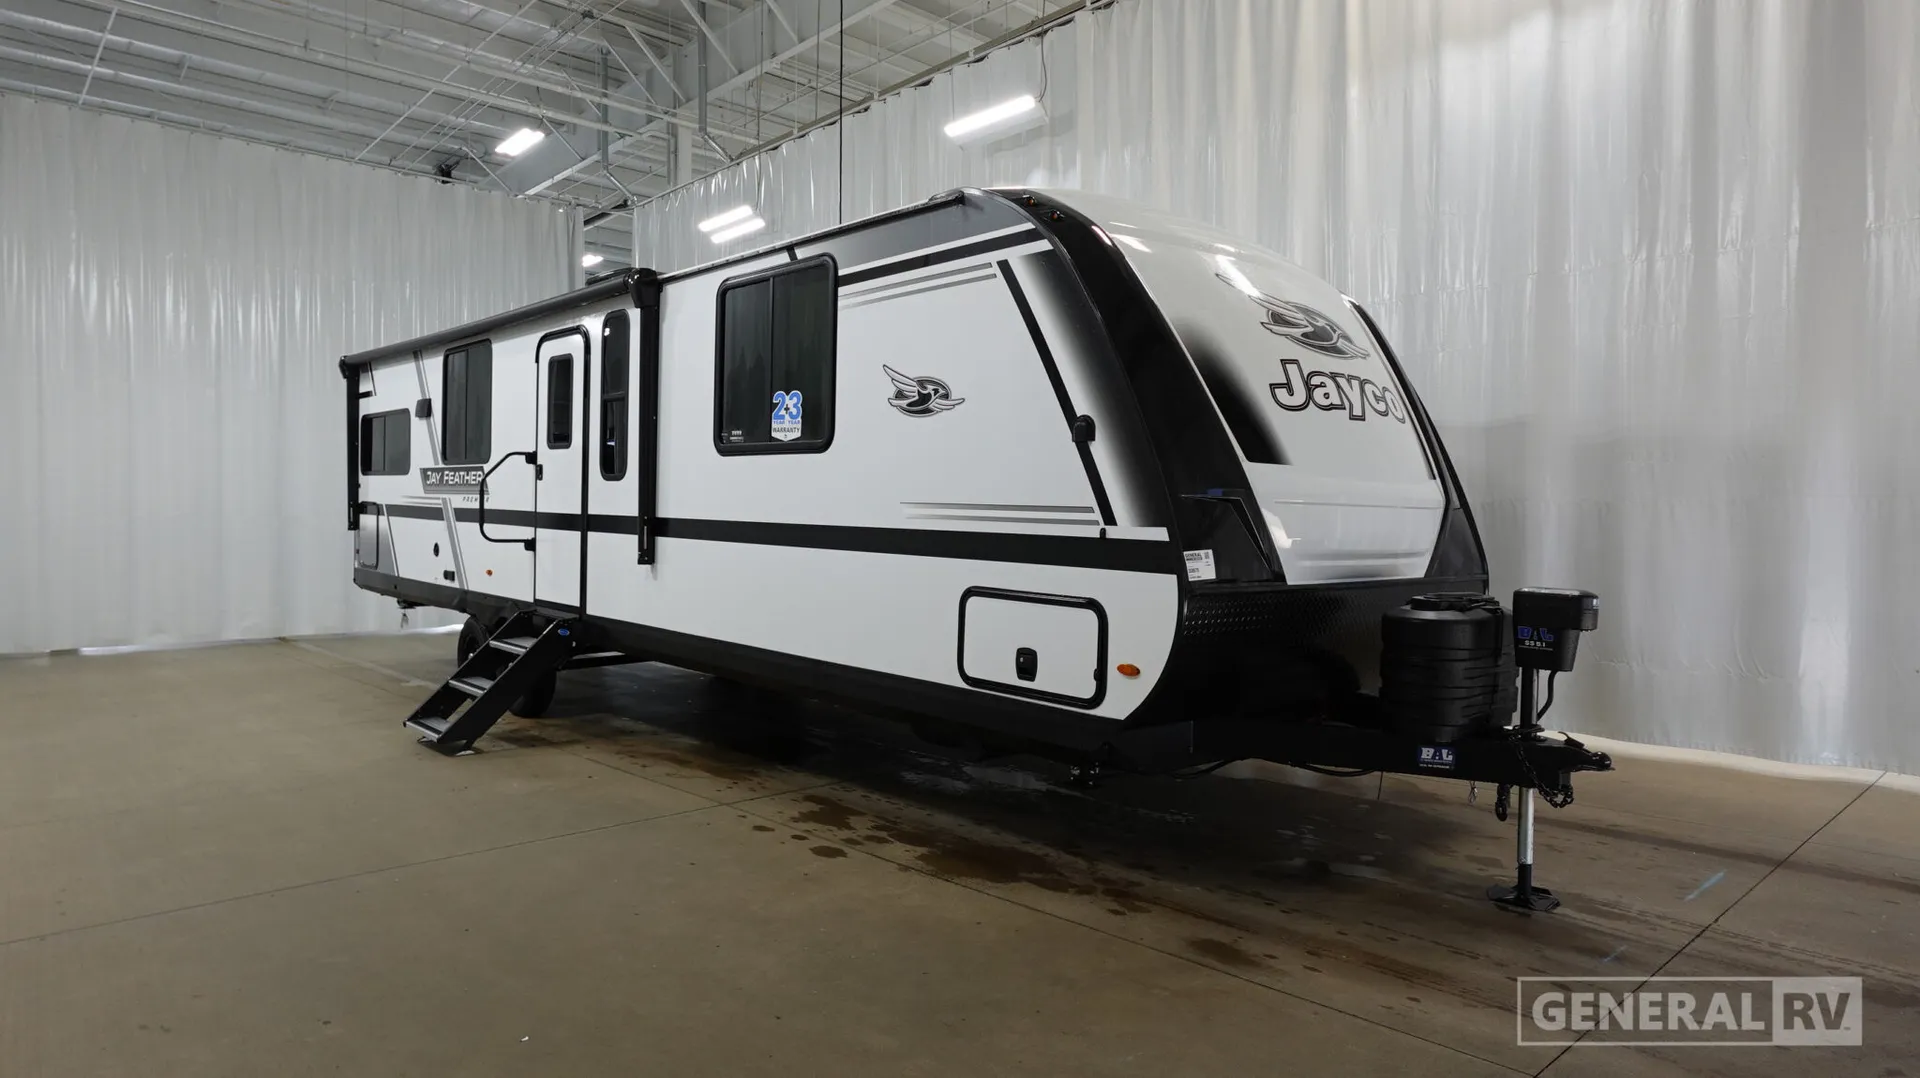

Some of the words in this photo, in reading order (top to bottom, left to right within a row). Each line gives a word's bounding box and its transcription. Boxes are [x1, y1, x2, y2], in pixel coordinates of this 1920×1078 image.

[1269, 358, 1405, 424] Jayco
[773, 426, 800, 434] WARRANTY
[426, 471, 441, 485] JAY
[443, 470, 484, 485] FEATHER
